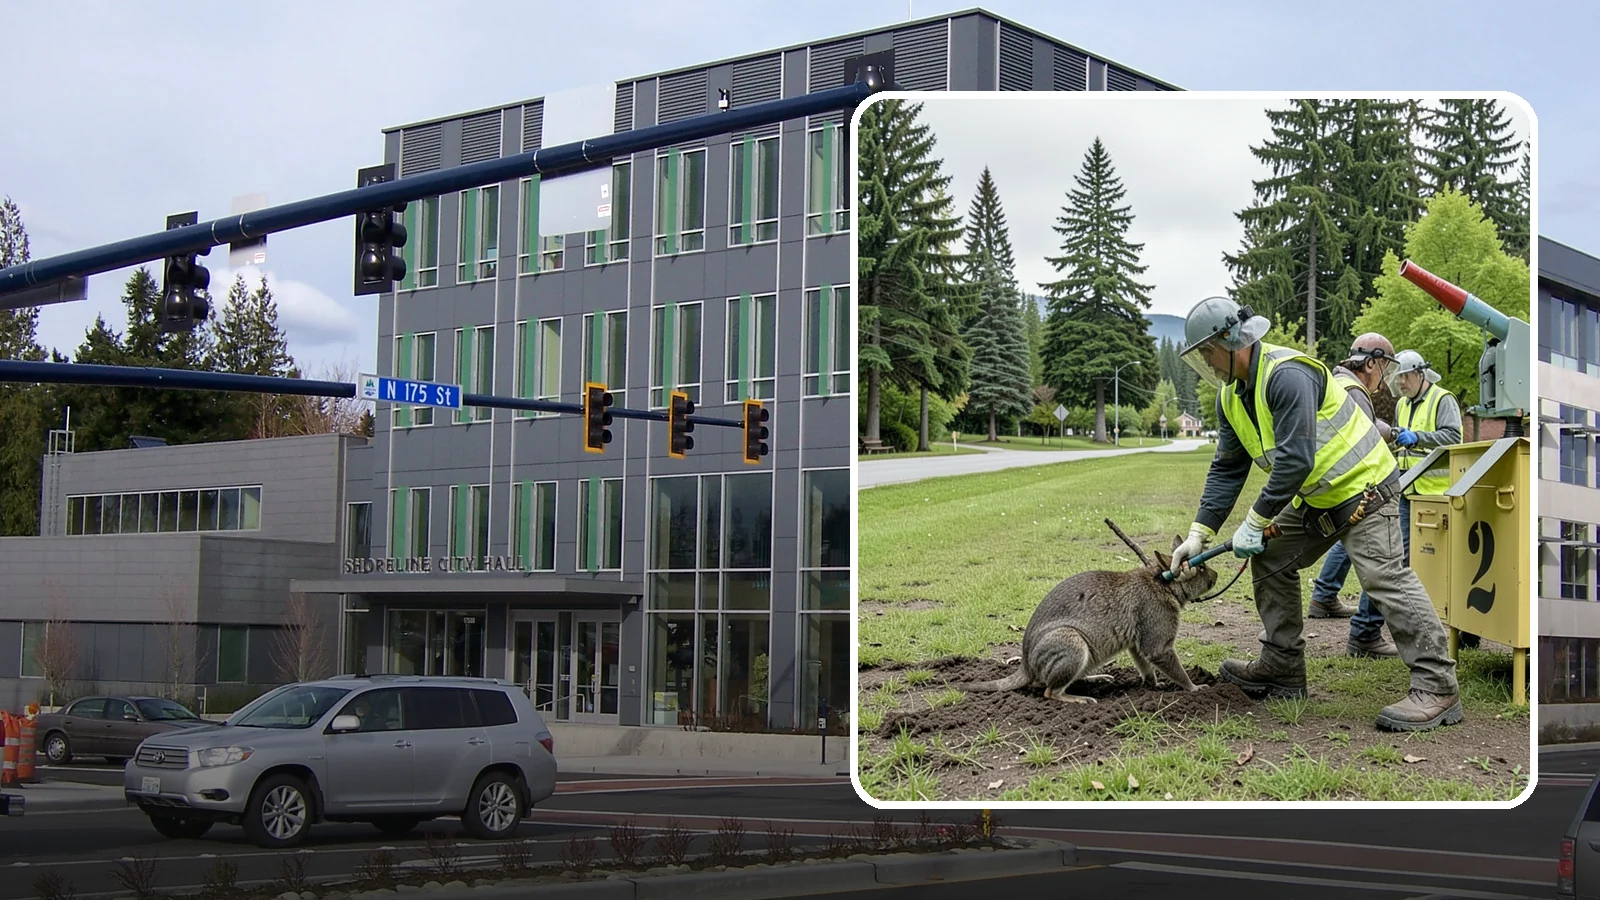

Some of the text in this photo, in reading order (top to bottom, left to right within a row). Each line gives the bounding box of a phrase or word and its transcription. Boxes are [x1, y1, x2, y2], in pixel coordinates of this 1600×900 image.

[387, 381, 450, 405] N 175 St
[344, 556, 525, 573] SHORELINE CITY HALL
[1467, 520, 1496, 614] 2
